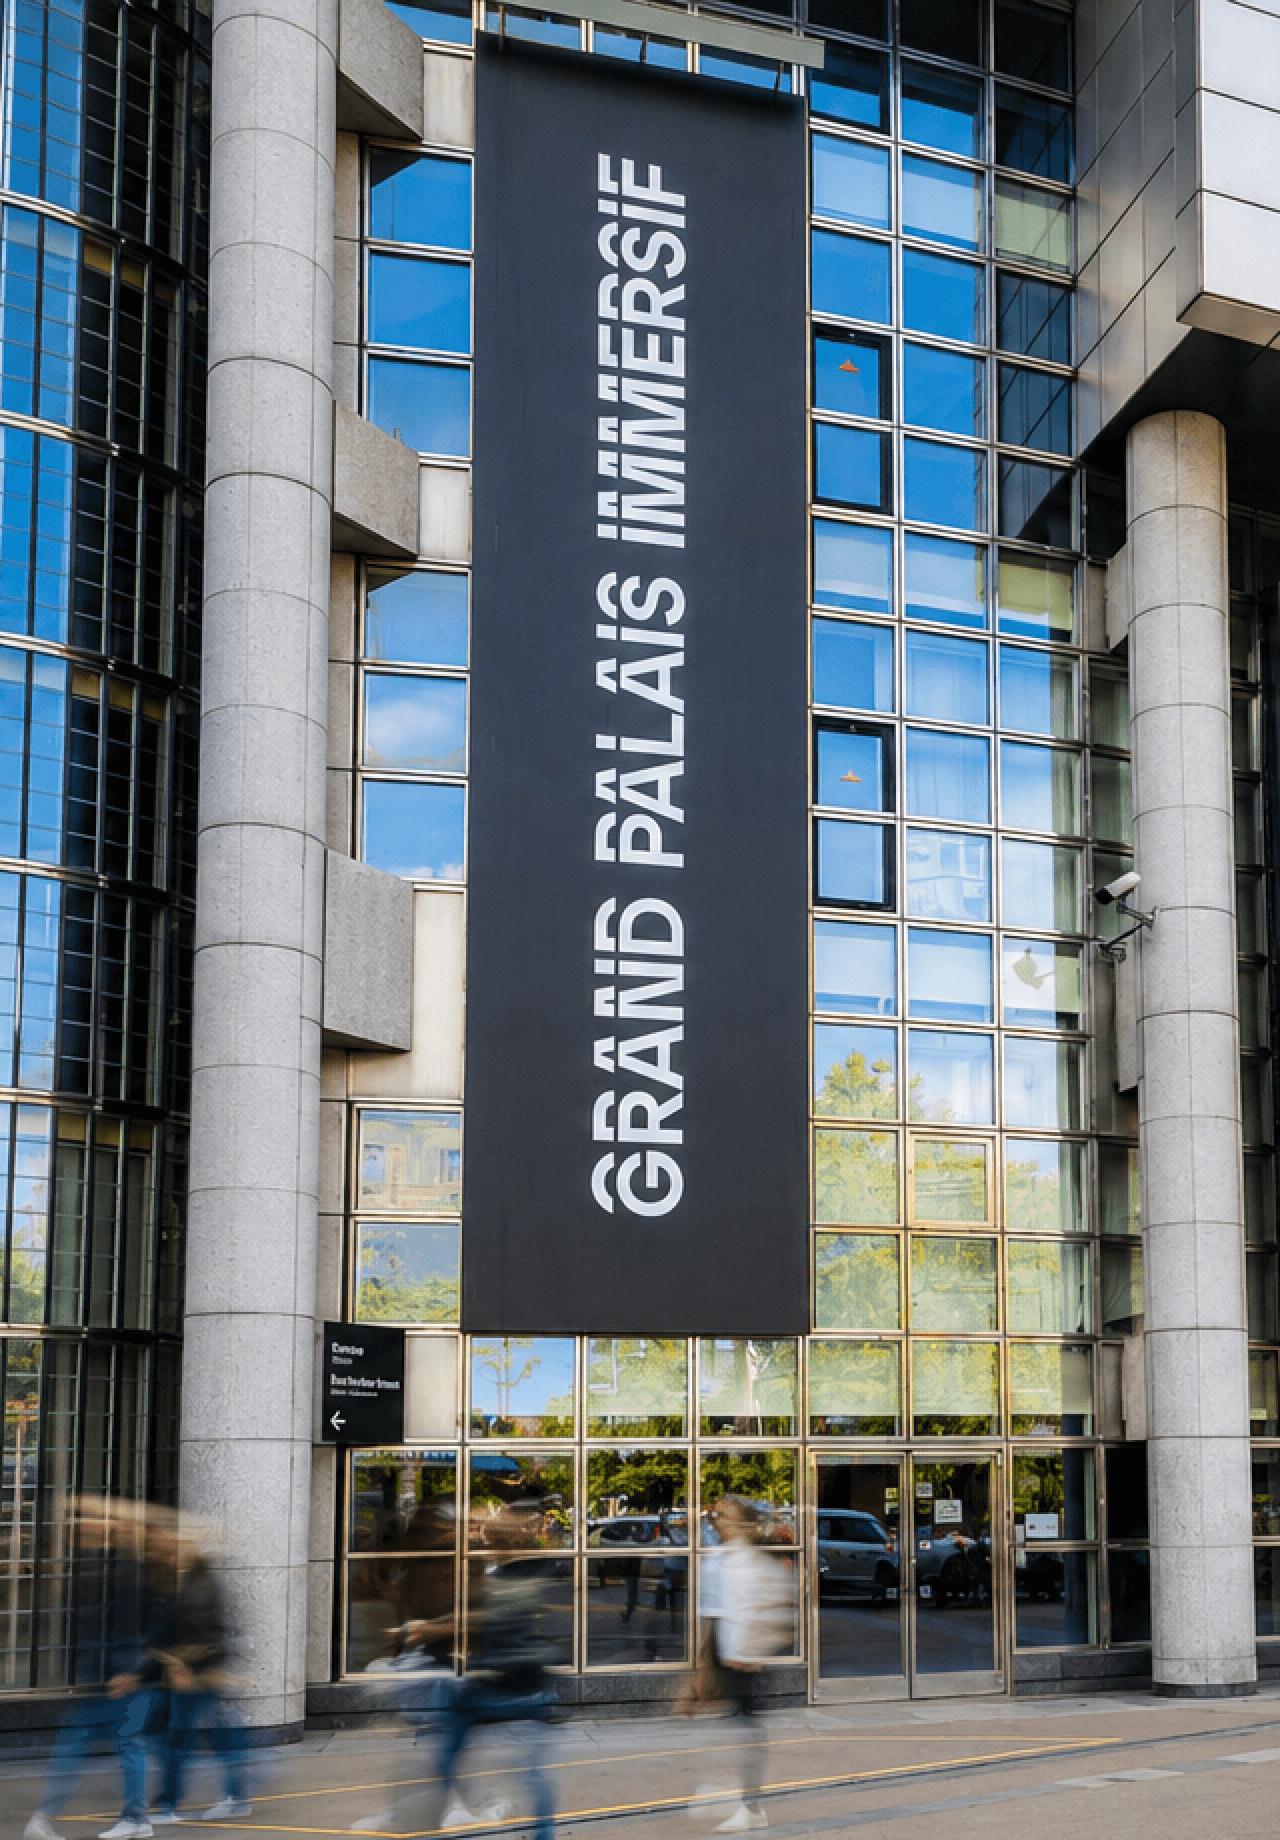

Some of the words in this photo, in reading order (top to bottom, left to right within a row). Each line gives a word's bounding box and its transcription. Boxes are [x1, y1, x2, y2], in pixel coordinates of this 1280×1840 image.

[597, 152, 687, 549] IMMERSIF
[594, 571, 685, 868] PALAIS
[591, 896, 685, 1218] GRAND
